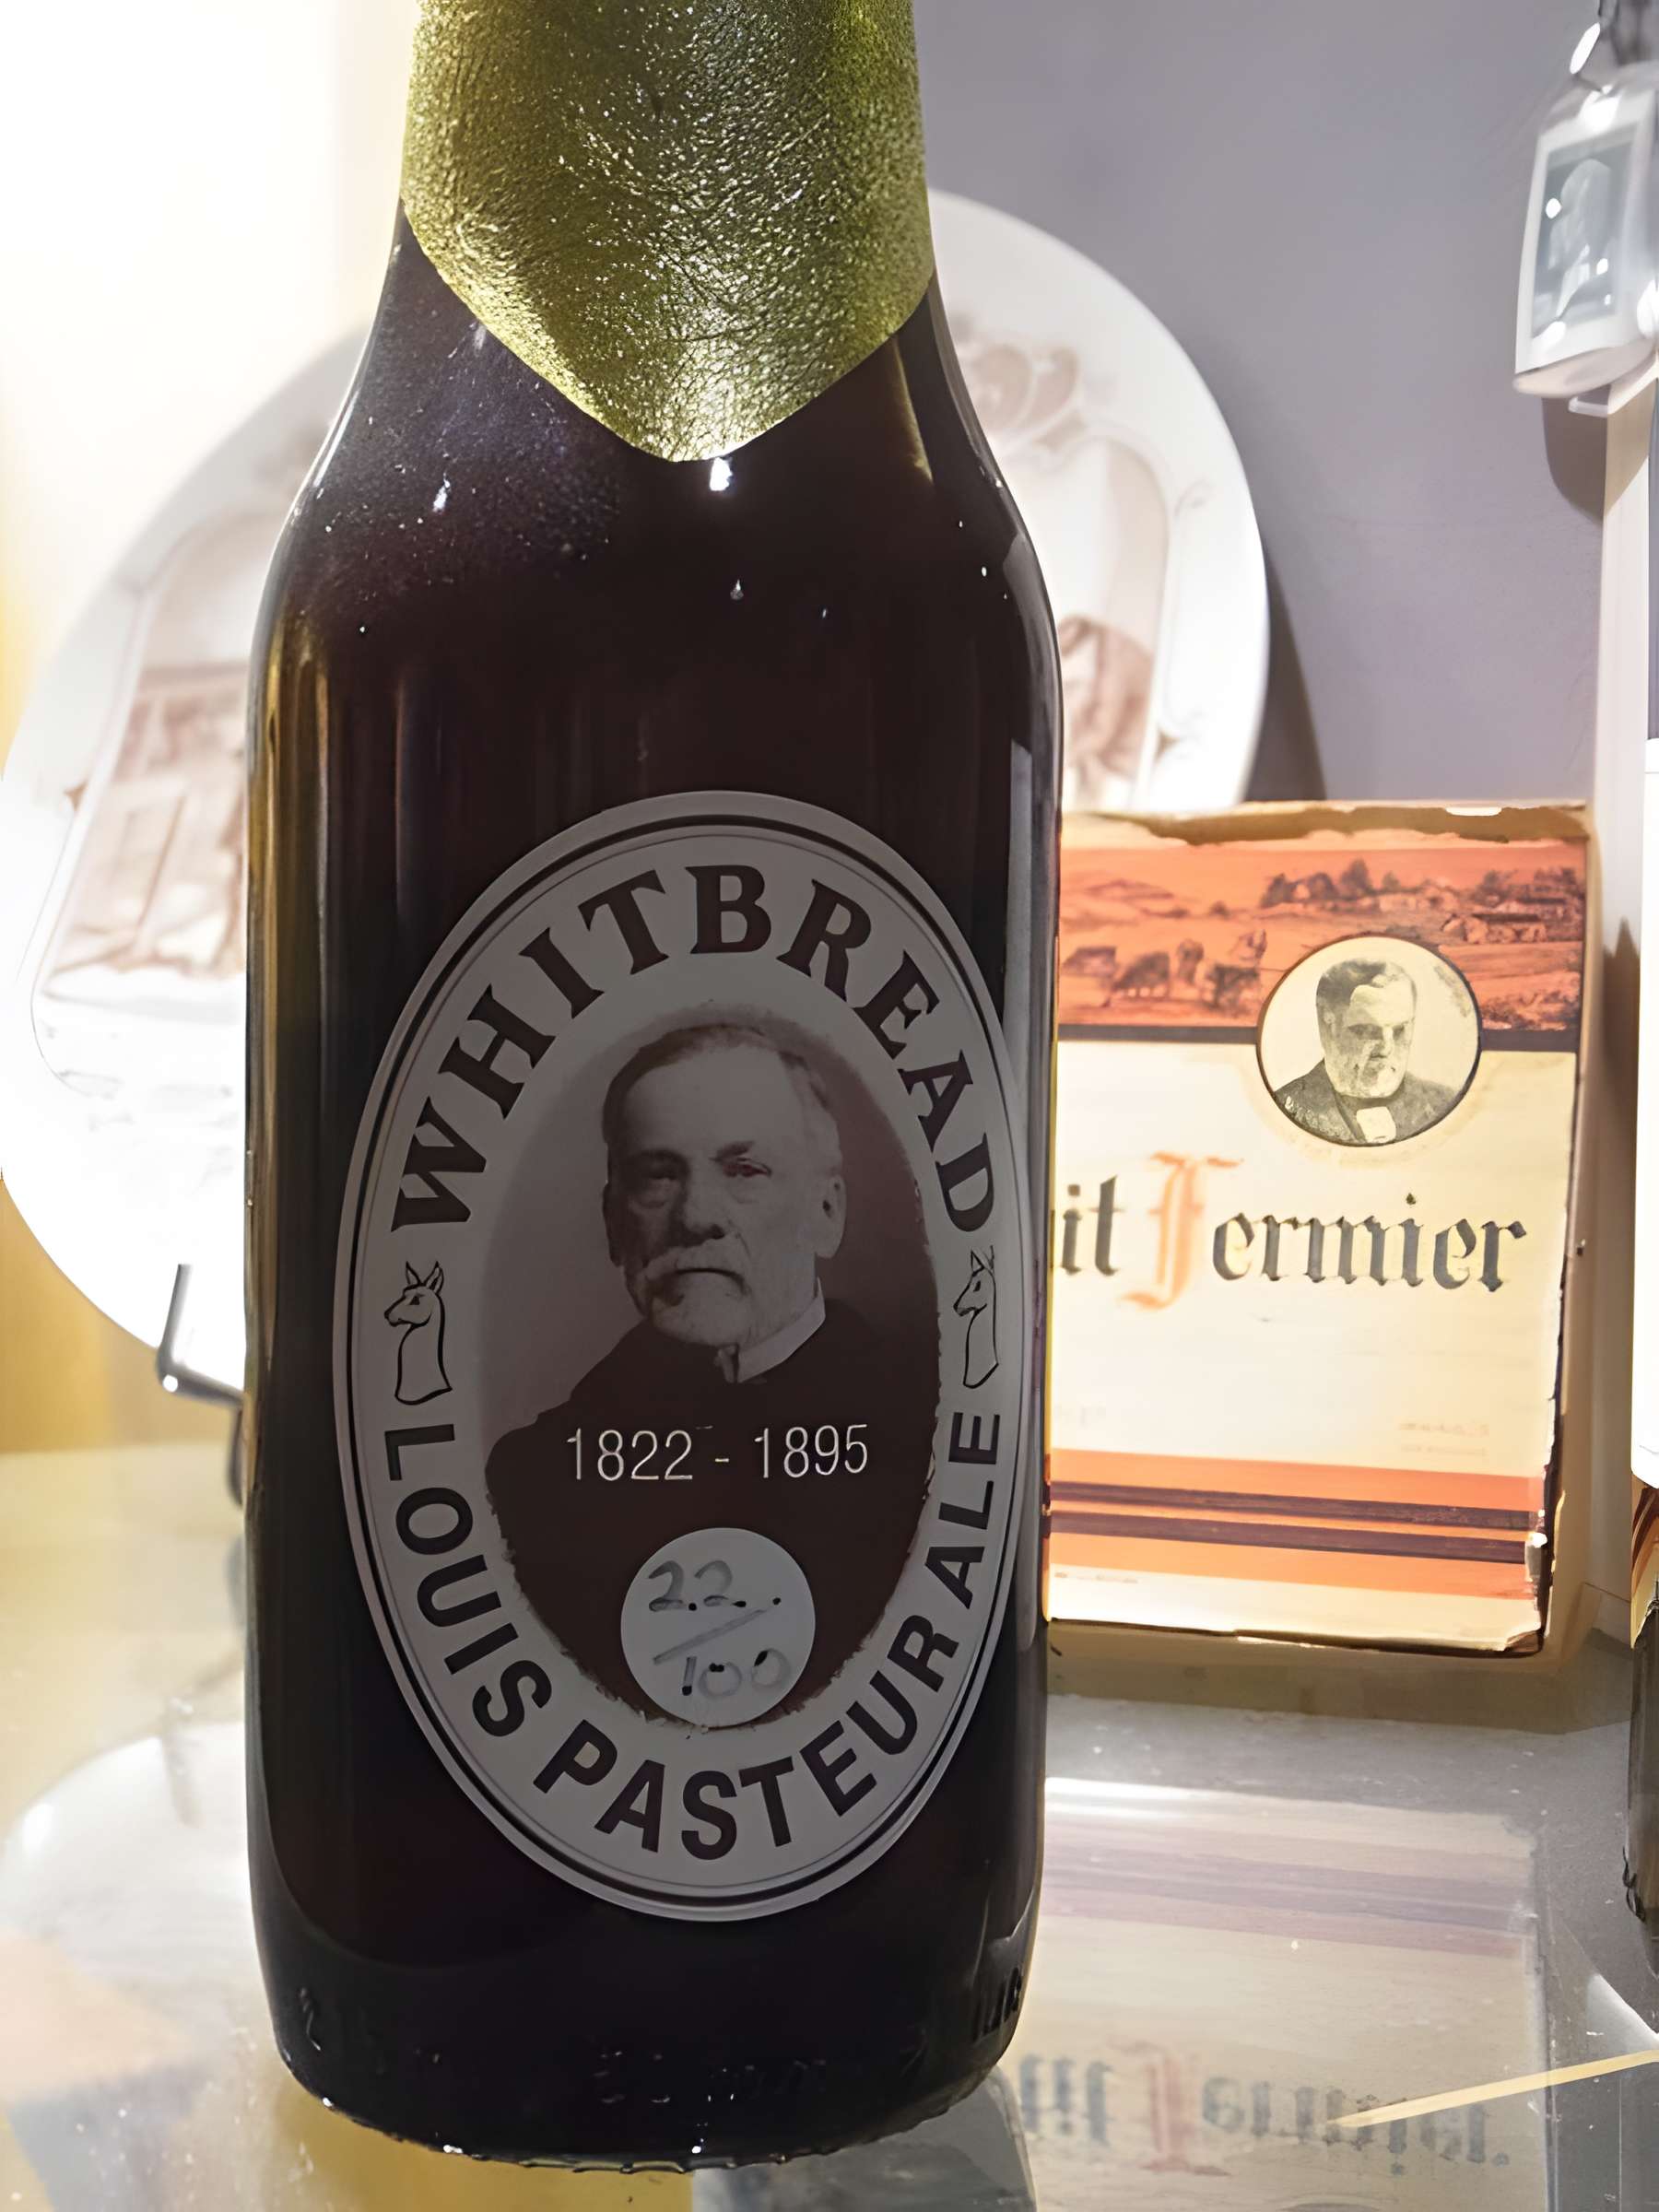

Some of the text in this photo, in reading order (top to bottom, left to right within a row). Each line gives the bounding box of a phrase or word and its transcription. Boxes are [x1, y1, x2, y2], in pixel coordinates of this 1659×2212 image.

[391, 864, 996, 1232] WHITBREAD
[1119, 1151, 1528, 1310] Fermier
[568, 1428, 693, 1481] 1822
[754, 1424, 868, 1478] 1895
[384, 1411, 1000, 1860] LOUIS PASTEUR ALE
